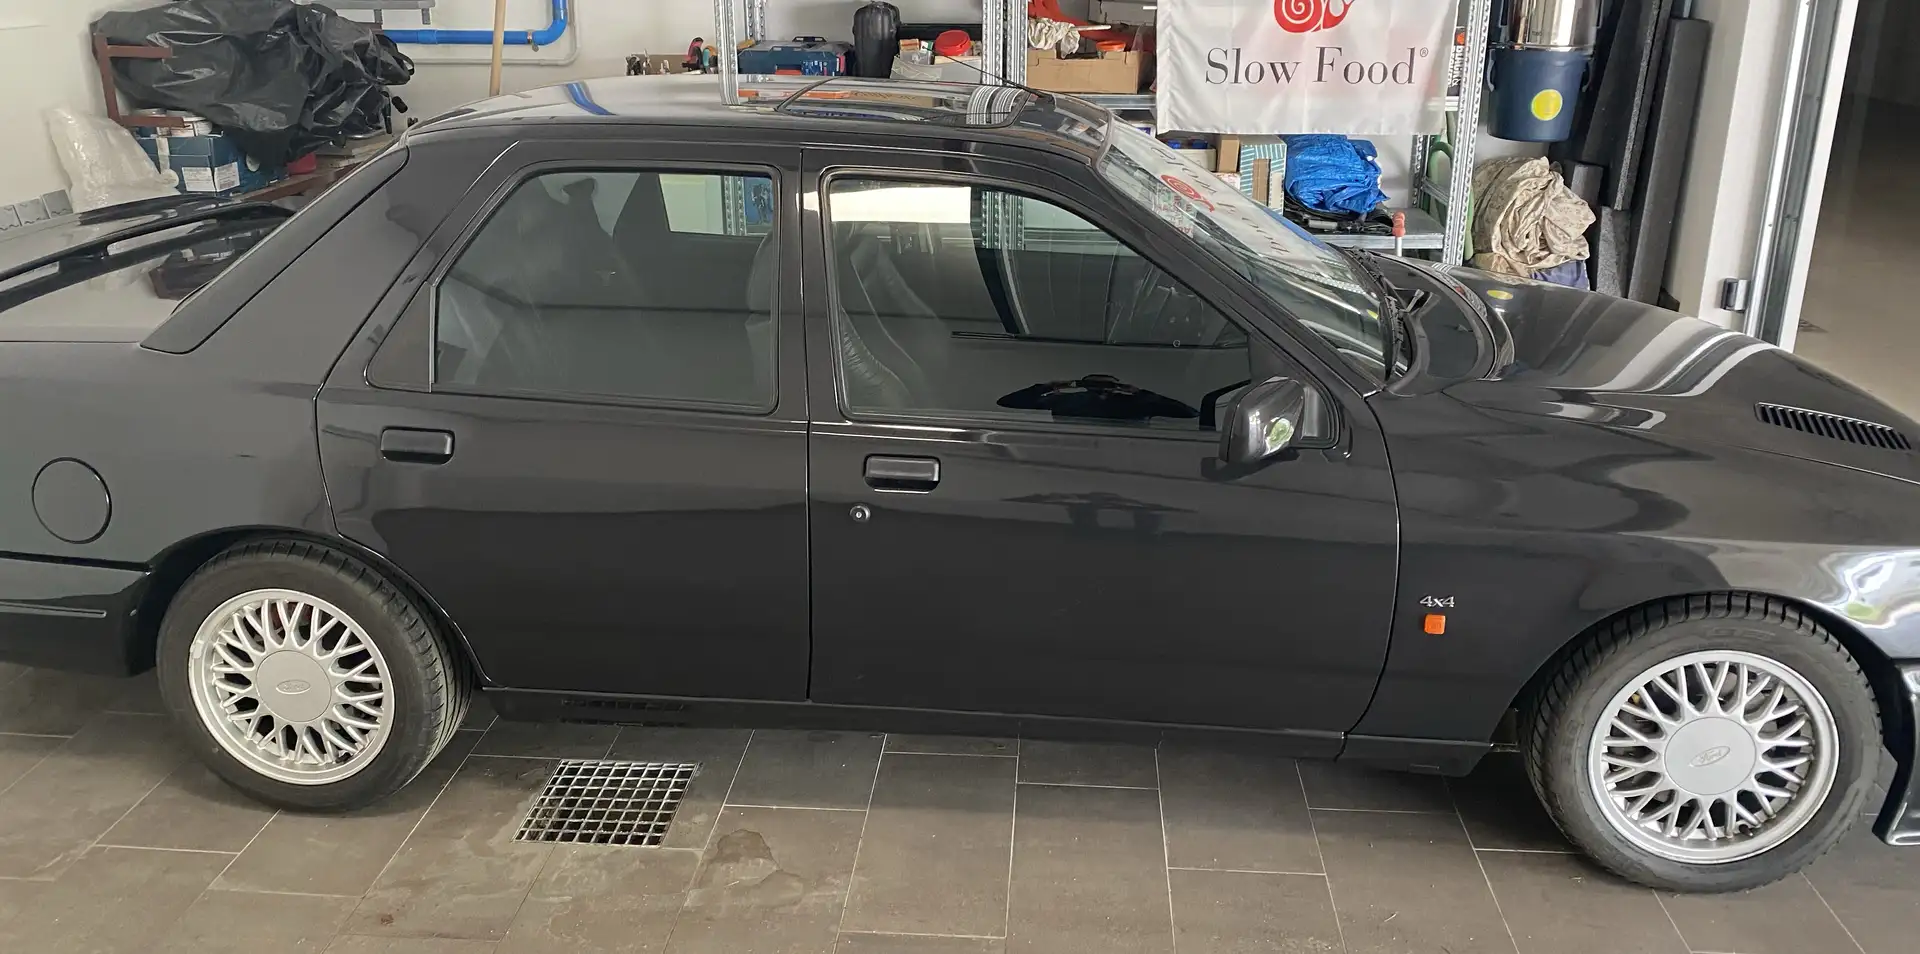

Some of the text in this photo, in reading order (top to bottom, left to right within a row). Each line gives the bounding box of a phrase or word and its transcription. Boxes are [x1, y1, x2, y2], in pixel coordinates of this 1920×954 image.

[1205, 47, 1302, 85] Slow
[1419, 595, 1455, 608] 4x4
[1694, 748, 1724, 765] Ford
